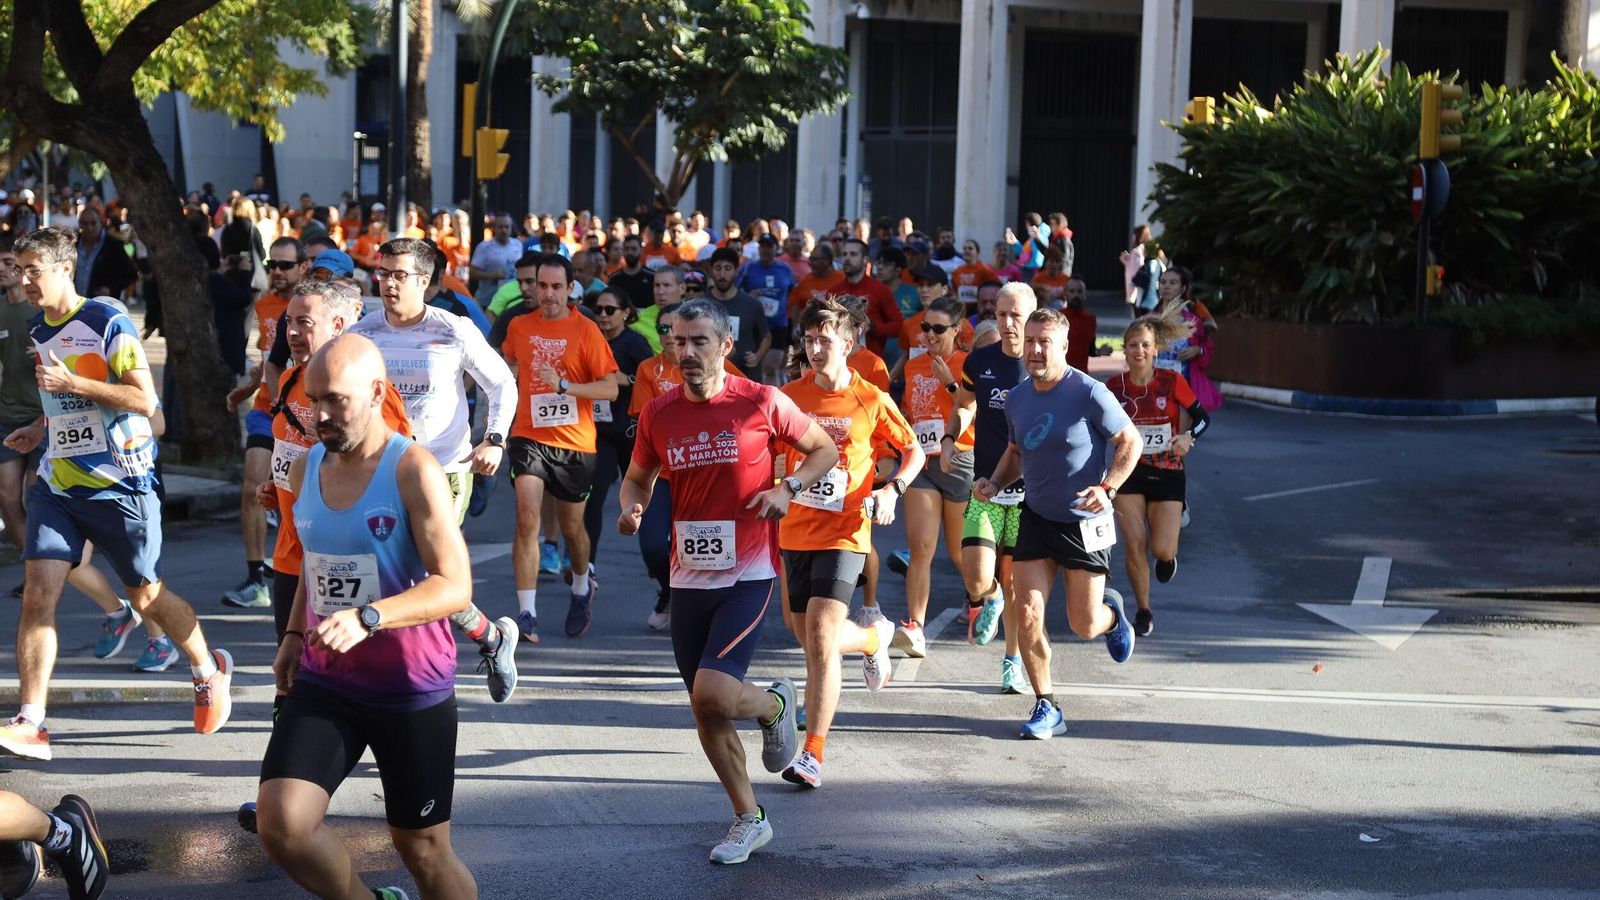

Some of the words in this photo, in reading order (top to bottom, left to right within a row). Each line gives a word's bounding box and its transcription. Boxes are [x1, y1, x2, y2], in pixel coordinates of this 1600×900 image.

[385, 359, 400, 368] SAN
[60, 400, 94, 410] 2024
[538, 404, 570, 417] 379
[593, 403, 602, 414] 8
[56, 426, 94, 445] 394
[1144, 434, 1164, 445] 73
[689, 443, 712, 452] MEDIA
[715, 440, 737, 448] 2022
[666, 446, 686, 465] IX
[689, 447, 738, 461] MARATÓN
[274, 456, 292, 476] 34
[669, 463, 687, 471] Ciudad
[808, 481, 835, 496] 23
[683, 538, 723, 555] 823
[317, 575, 362, 598] 527
